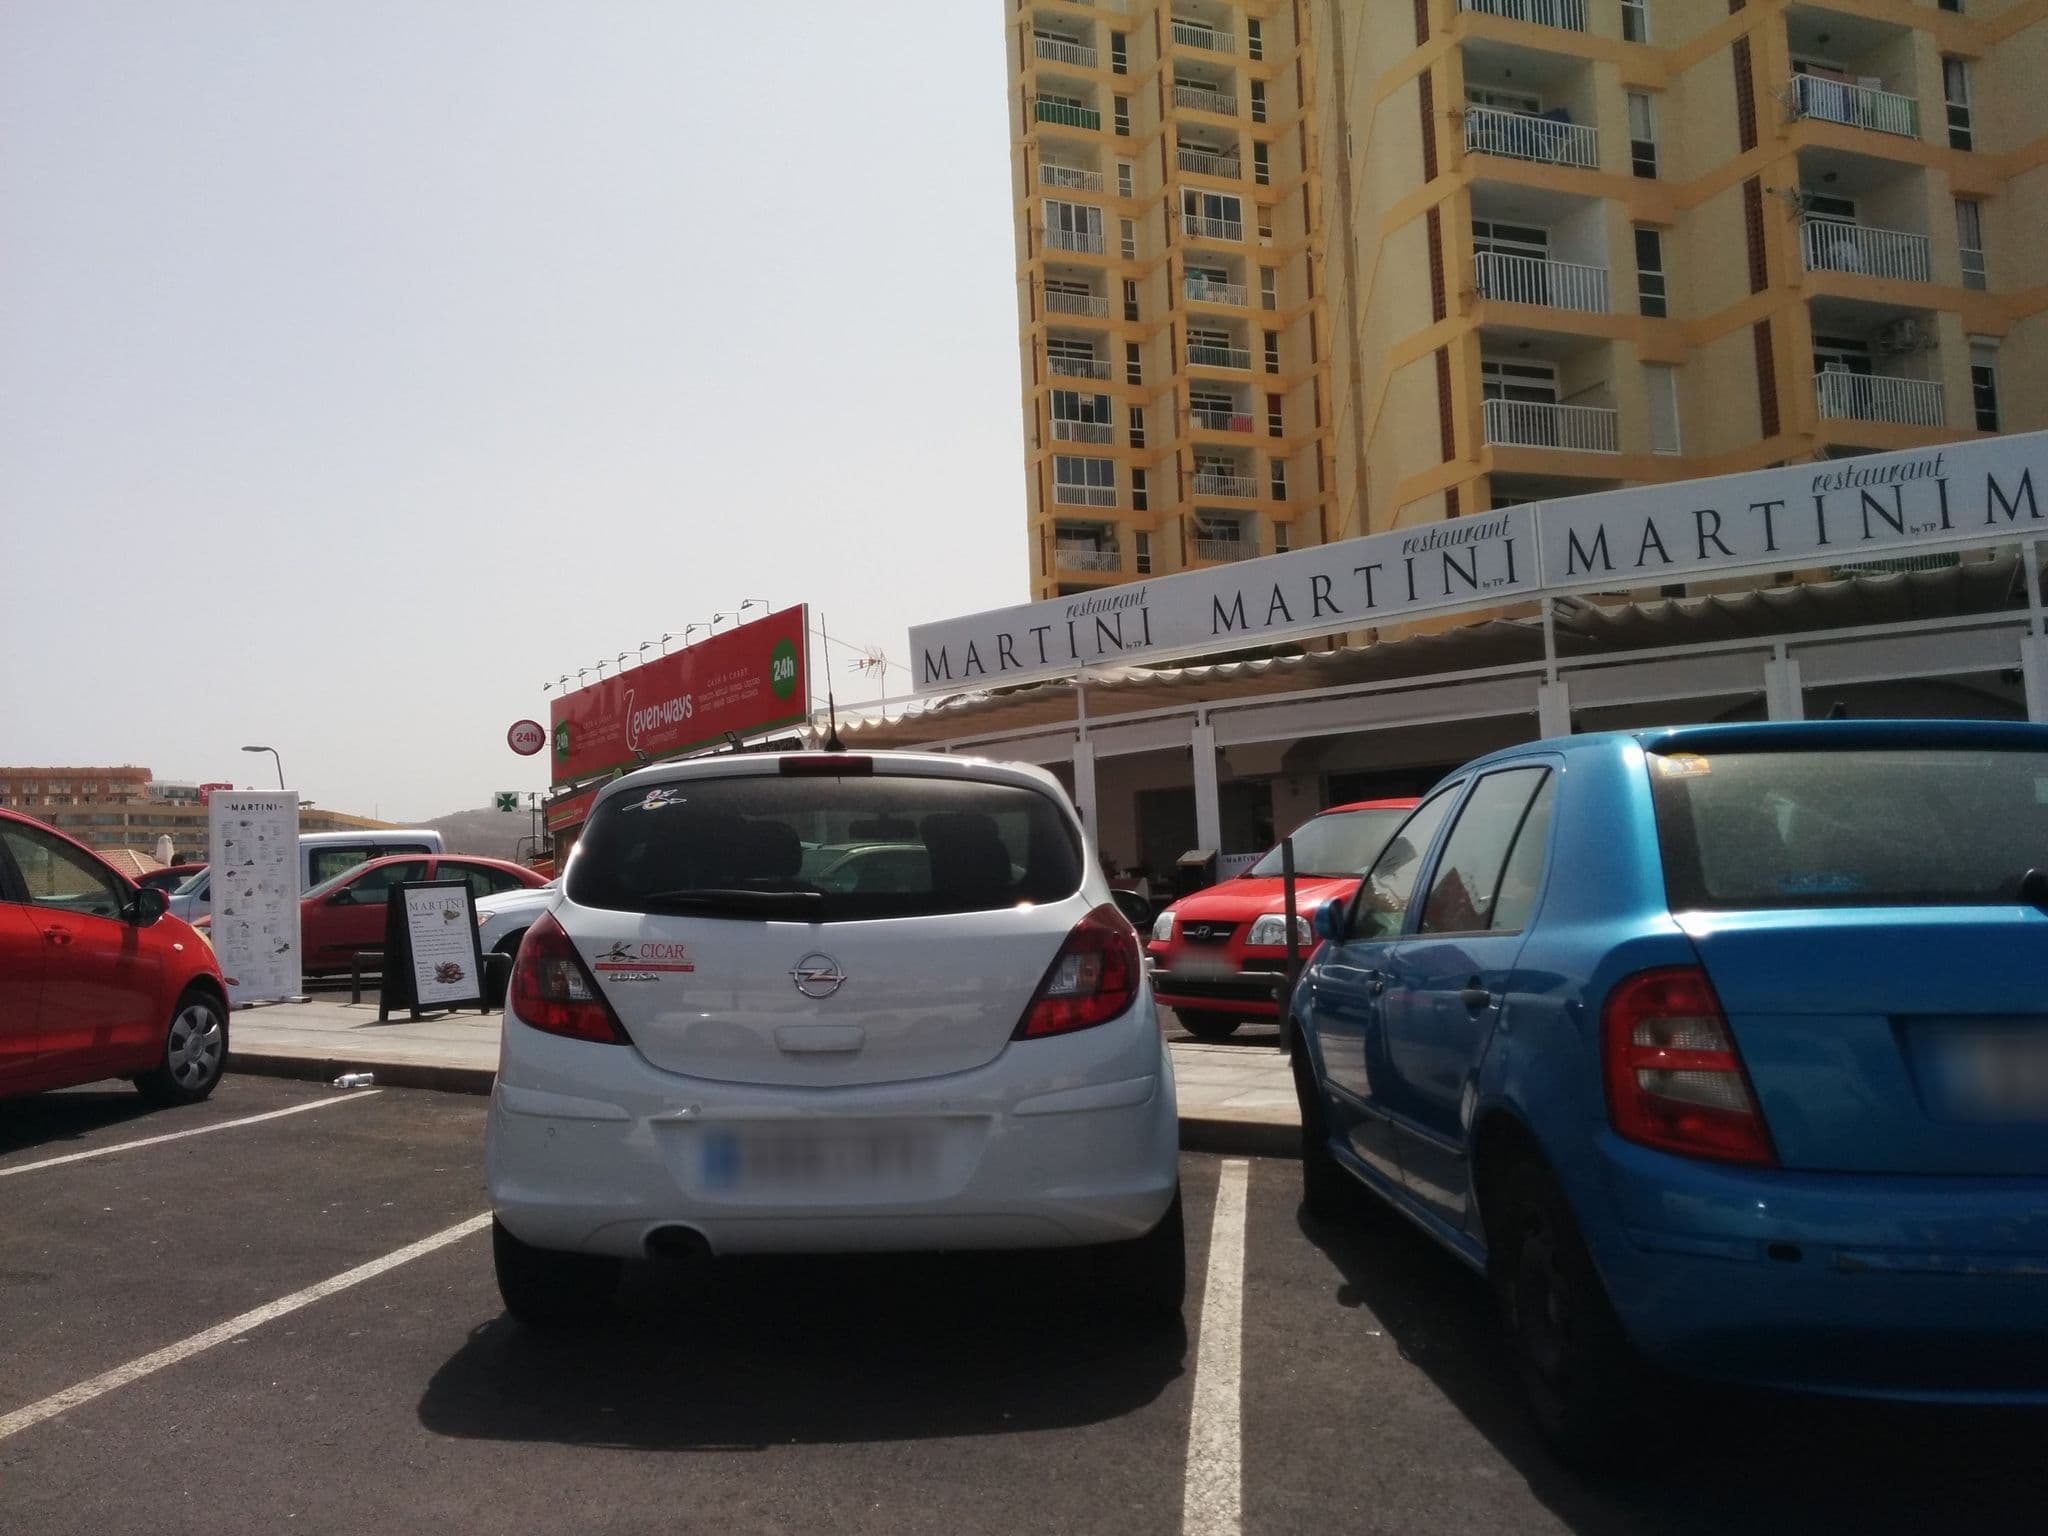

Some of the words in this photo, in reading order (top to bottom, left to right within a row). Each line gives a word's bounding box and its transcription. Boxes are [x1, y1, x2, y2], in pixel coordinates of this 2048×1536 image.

[1812, 452, 1948, 493] restaurant
[1402, 514, 1513, 555] restaurant
[1565, 478, 1956, 577] MARTINI
[1211, 538, 1520, 635] MARTINI
[1066, 586, 1149, 619] restaurant
[924, 607, 1154, 684] MARTINI
[773, 657, 794, 681] 24h
[516, 731, 537, 743] 24h
[555, 731, 569, 751] 24h
[231, 803, 278, 811] MARTINI
[409, 900, 465, 911] MARTINI
[640, 943, 685, 958] CICAR
